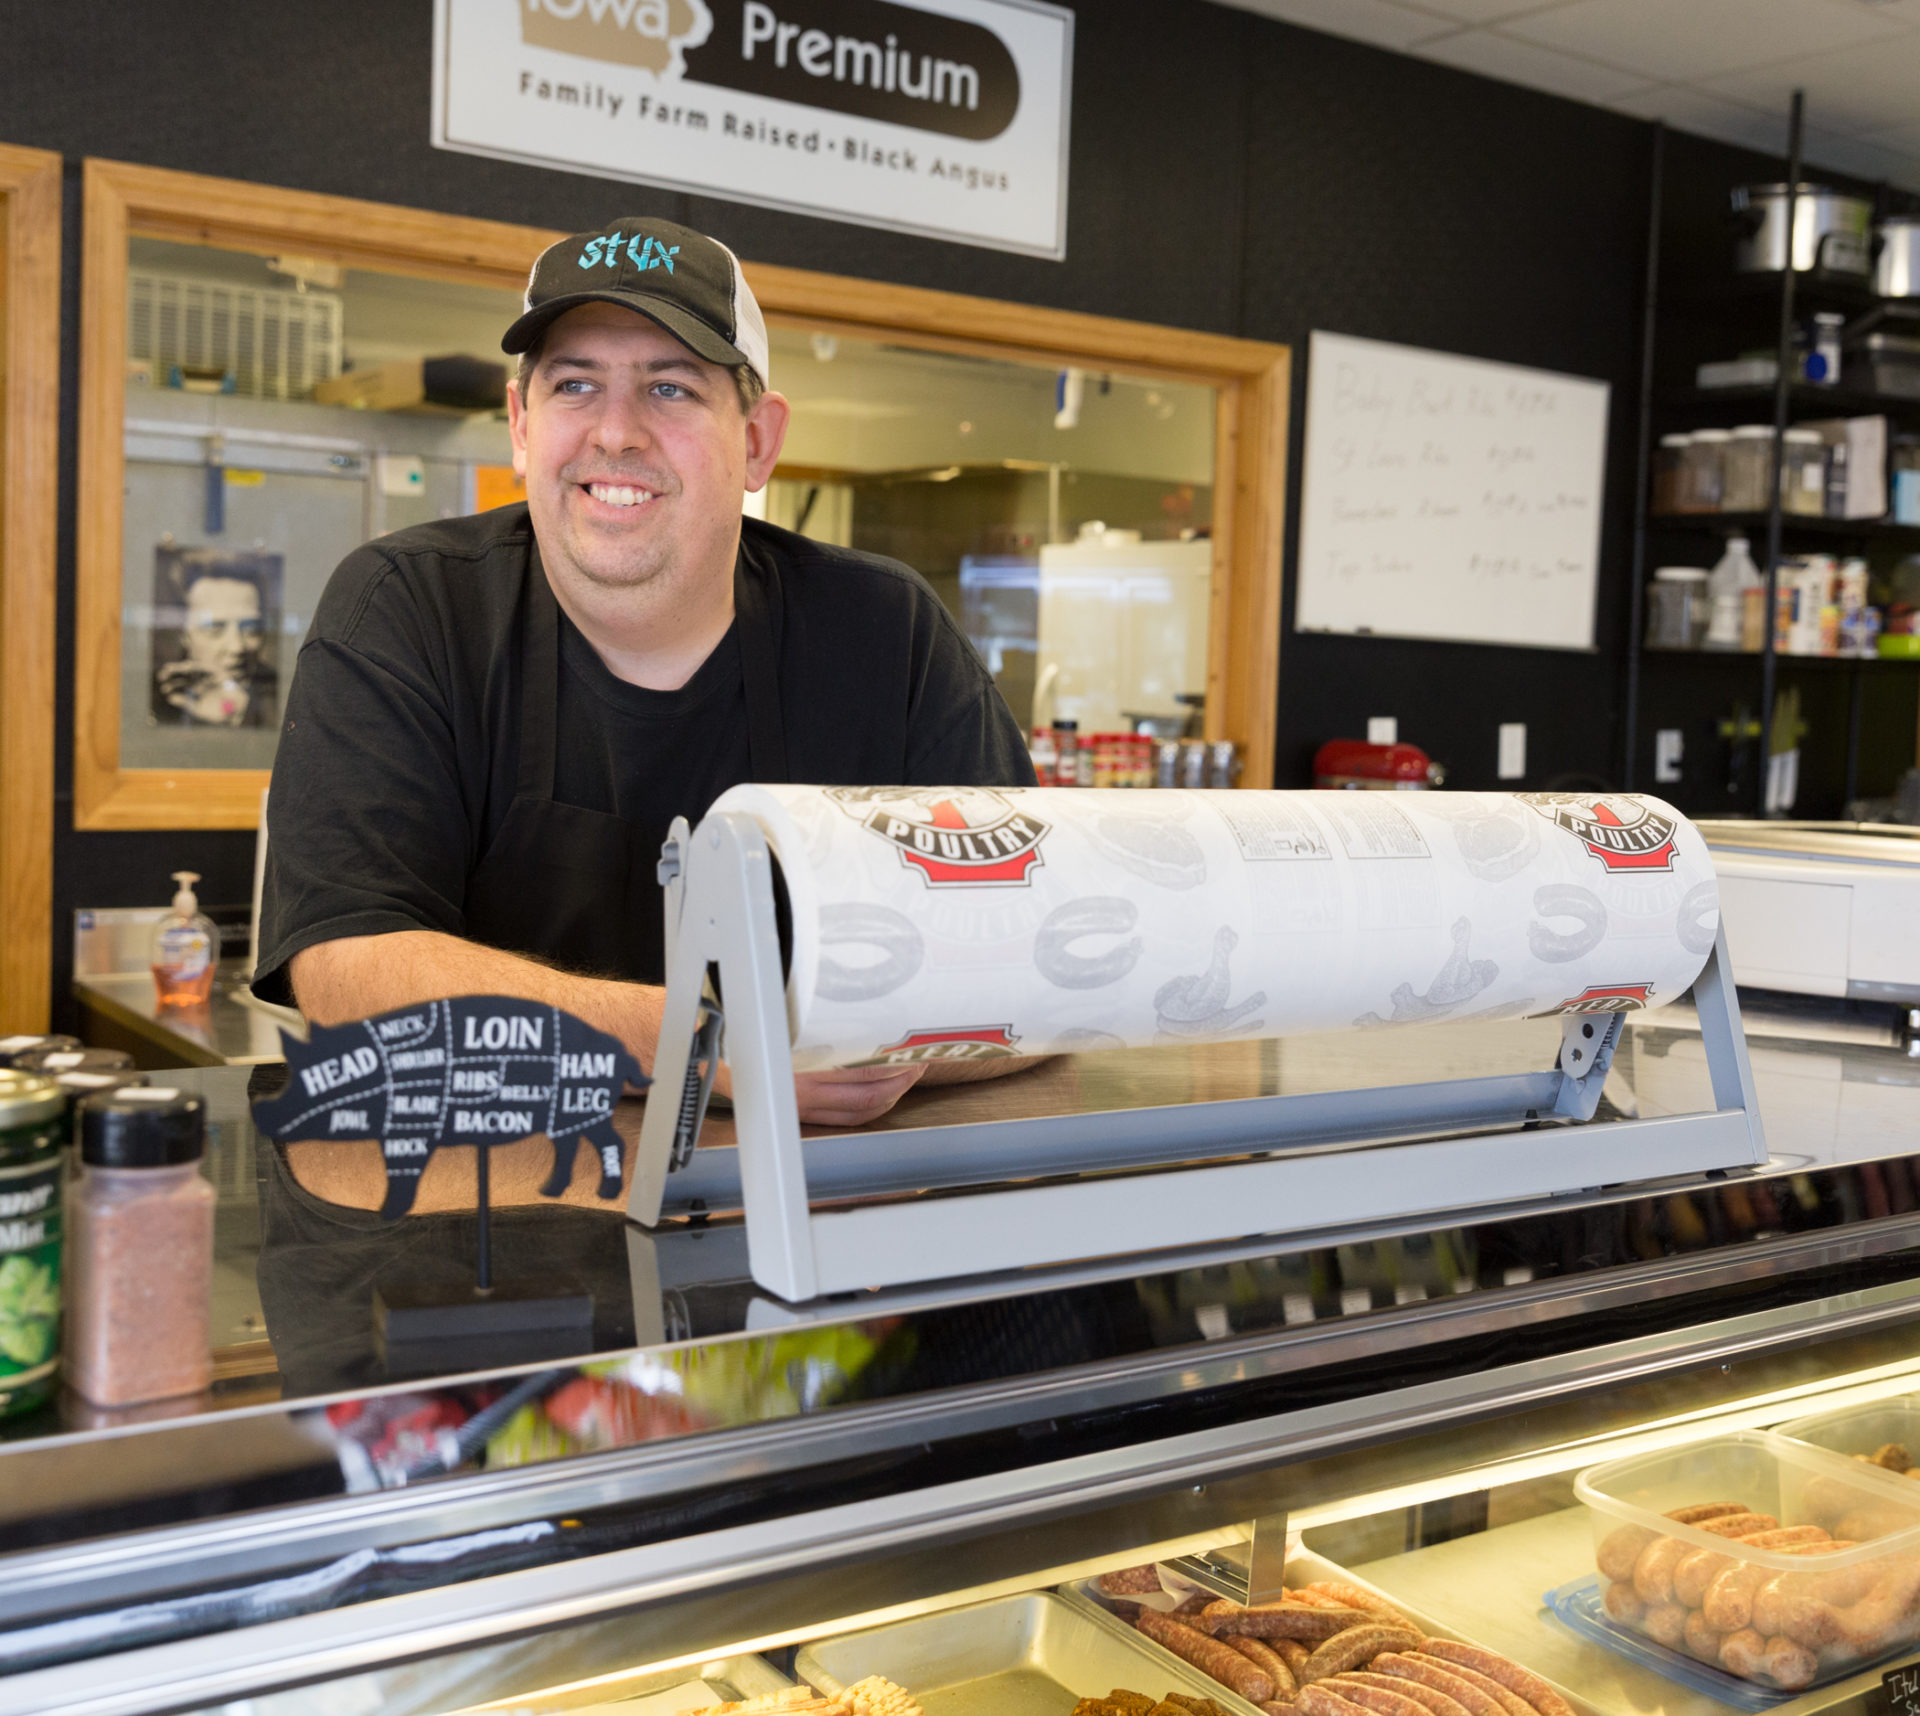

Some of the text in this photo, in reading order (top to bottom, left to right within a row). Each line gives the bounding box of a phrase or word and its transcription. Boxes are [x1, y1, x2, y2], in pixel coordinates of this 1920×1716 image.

[742, 1, 979, 110] Premium
[520, 71, 1010, 191] Family Farm Raised Black Angus
[886, 816, 1036, 860] POULTRY
[1570, 816, 1669, 850] POULTRY
[1561, 998, 1633, 1014] MEAT
[464, 1016, 544, 1050] LOIN
[300, 1046, 378, 1098] HEAD
[560, 1052, 616, 1079] HAM
[452, 1070, 499, 1092] RIBS
[500, 1084, 552, 1101] BELLY
[562, 1087, 611, 1113] LEG
[453, 1110, 533, 1133] BACON
